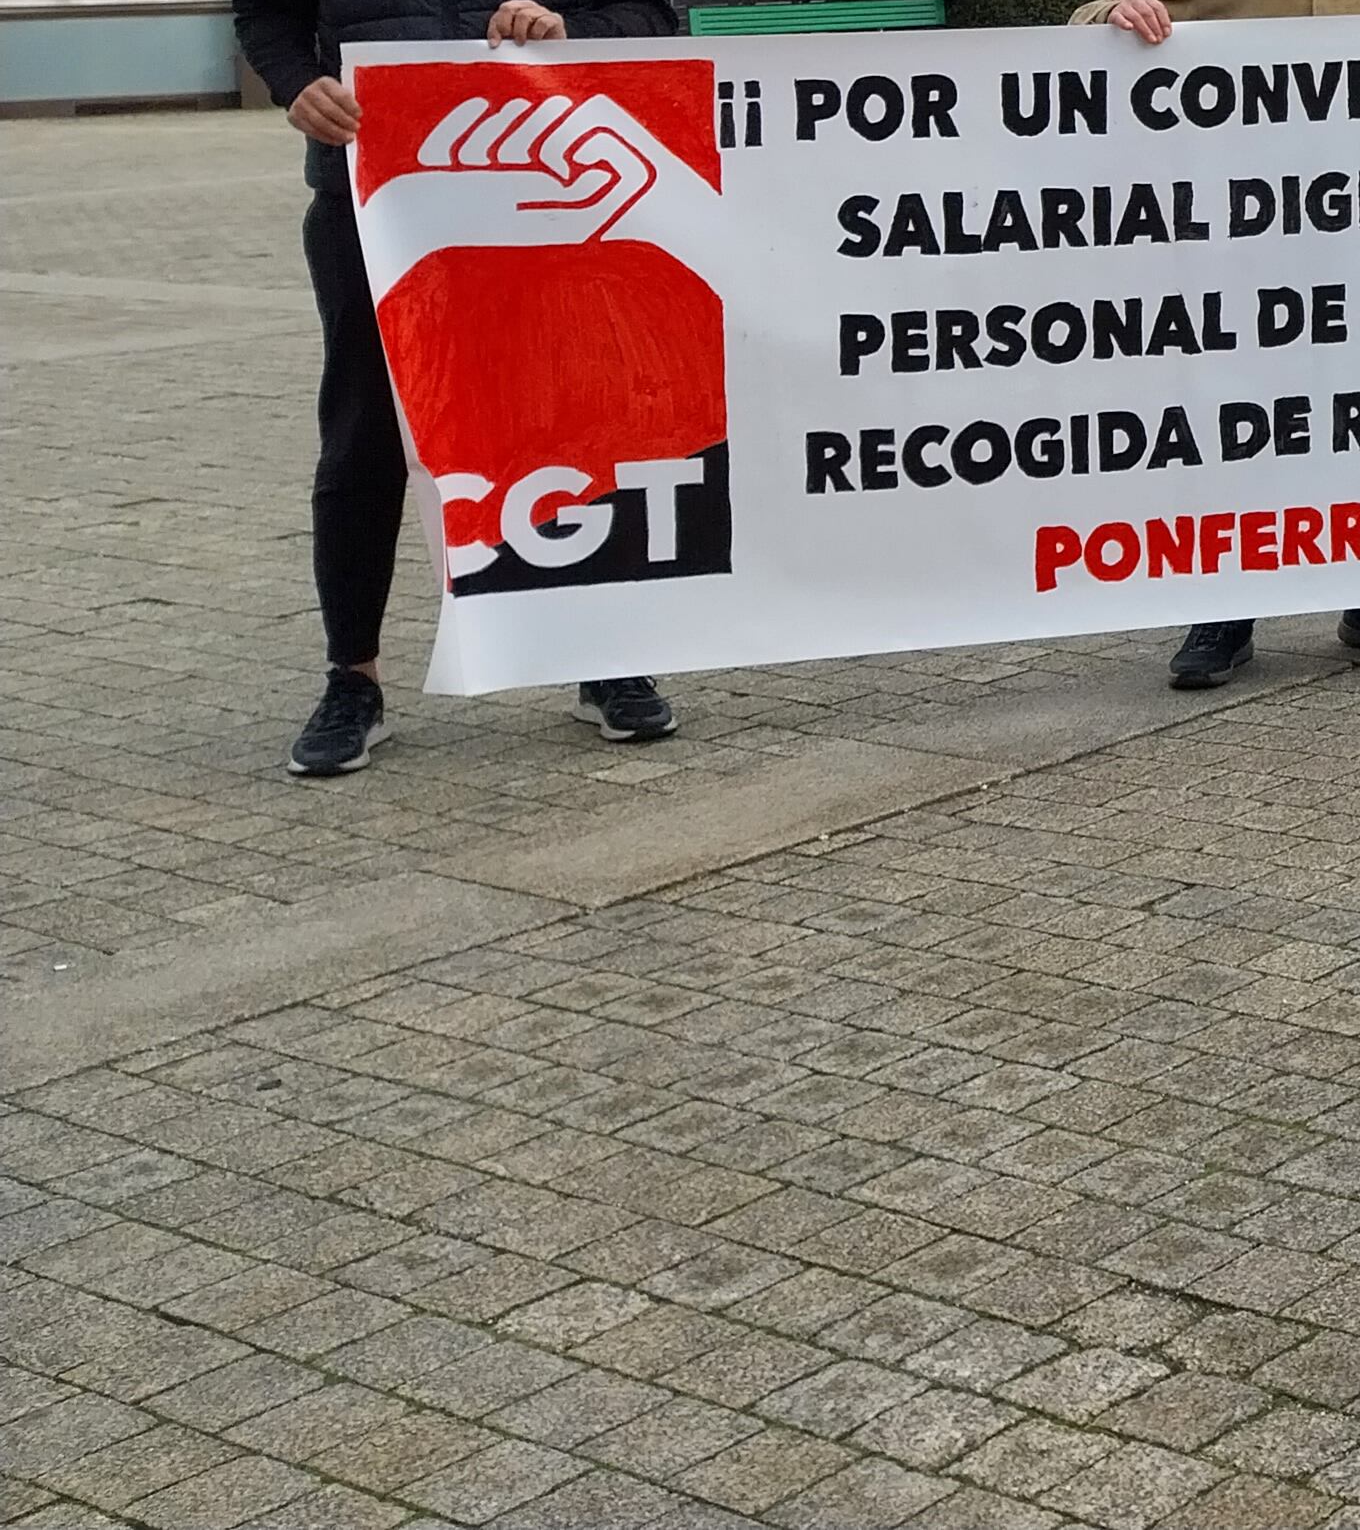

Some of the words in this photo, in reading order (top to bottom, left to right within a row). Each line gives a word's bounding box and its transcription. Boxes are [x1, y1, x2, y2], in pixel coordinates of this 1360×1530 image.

[795, 73, 960, 142] POR
[1001, 69, 1108, 137] UN
[836, 181, 1210, 258] SALARIAL
[839, 291, 1237, 376] PERSONAL
[1257, 283, 1348, 349] DE
[805, 405, 1203, 495] RECOGIDA
[1219, 395, 1313, 463] DE
[435, 457, 704, 579] CGT
